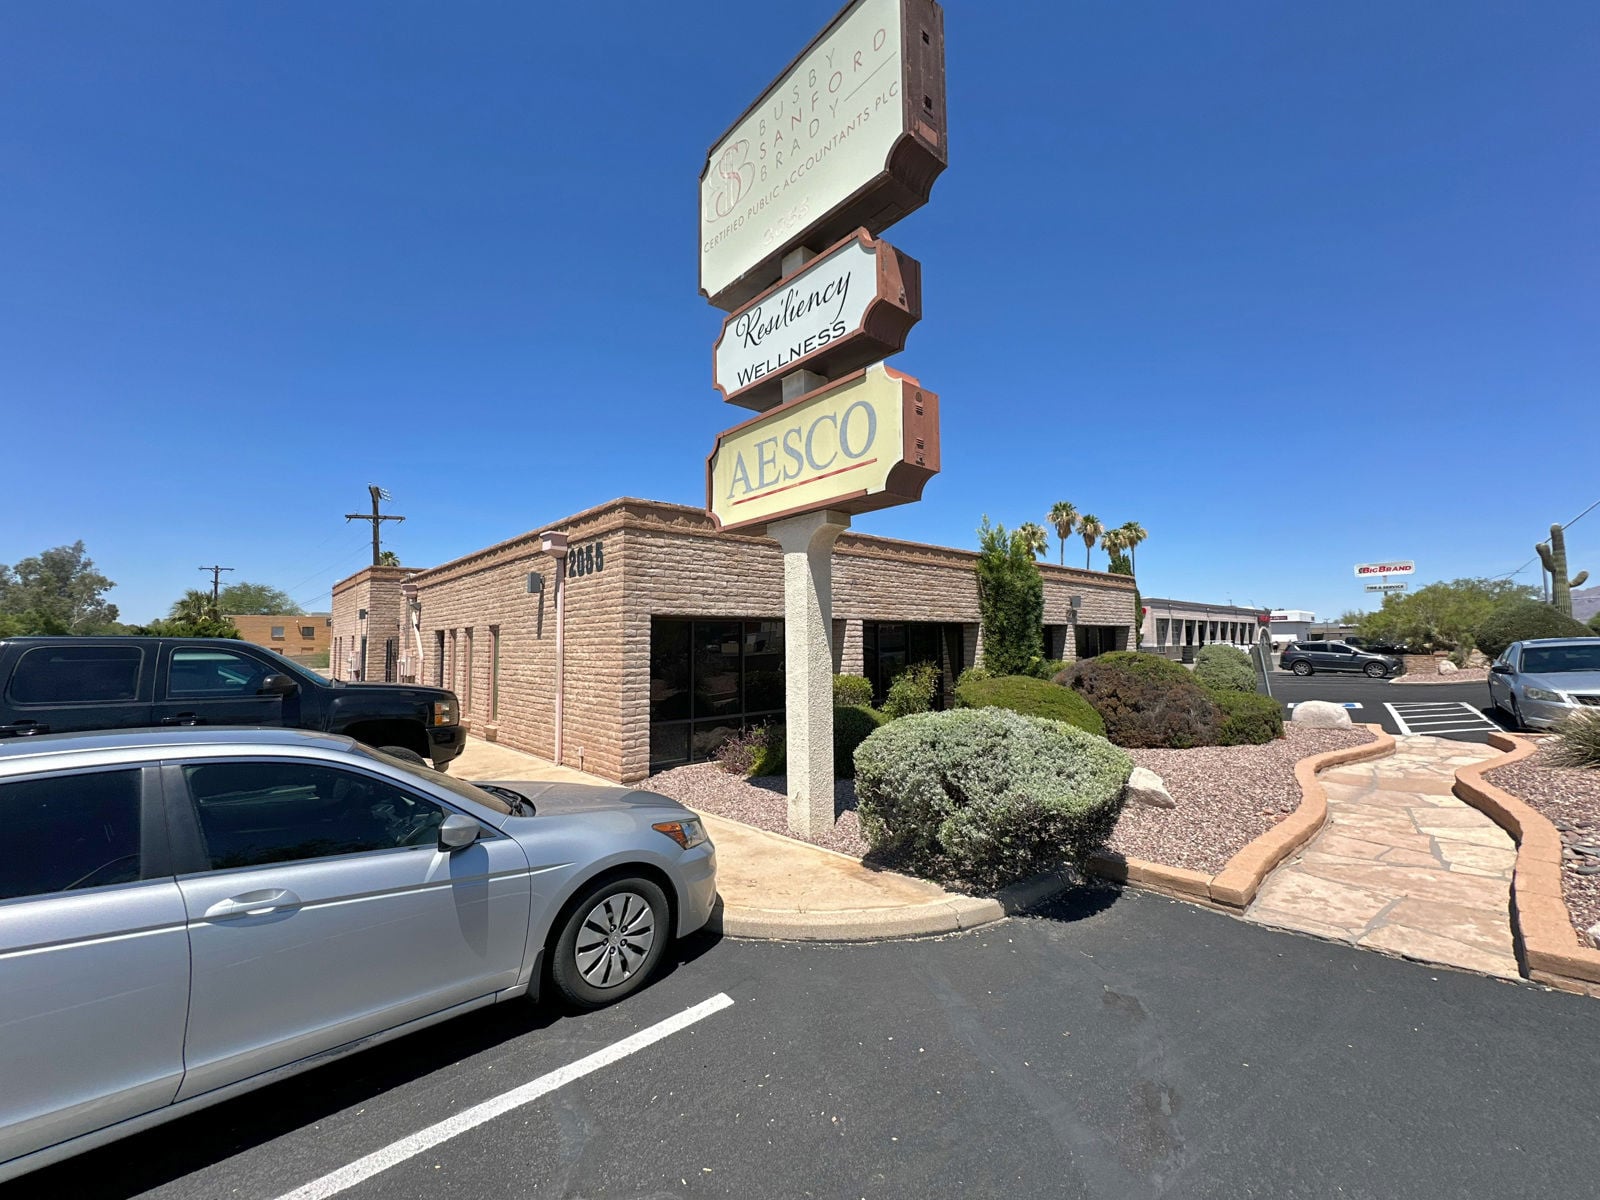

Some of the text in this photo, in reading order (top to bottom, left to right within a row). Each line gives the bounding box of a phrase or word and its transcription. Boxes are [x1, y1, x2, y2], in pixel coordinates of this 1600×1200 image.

[759, 48, 835, 137] BUSBY
[760, 28, 886, 160] SANFORD
[703, 80, 899, 254] CERTIFIED PUBLIC ACCOUNTANTS PLC
[760, 98, 840, 183] BRADY
[735, 271, 852, 349] Resiliency
[737, 320, 847, 387] WELLNESS
[726, 400, 878, 500] AESCO
[568, 541, 604, 578] 2055
